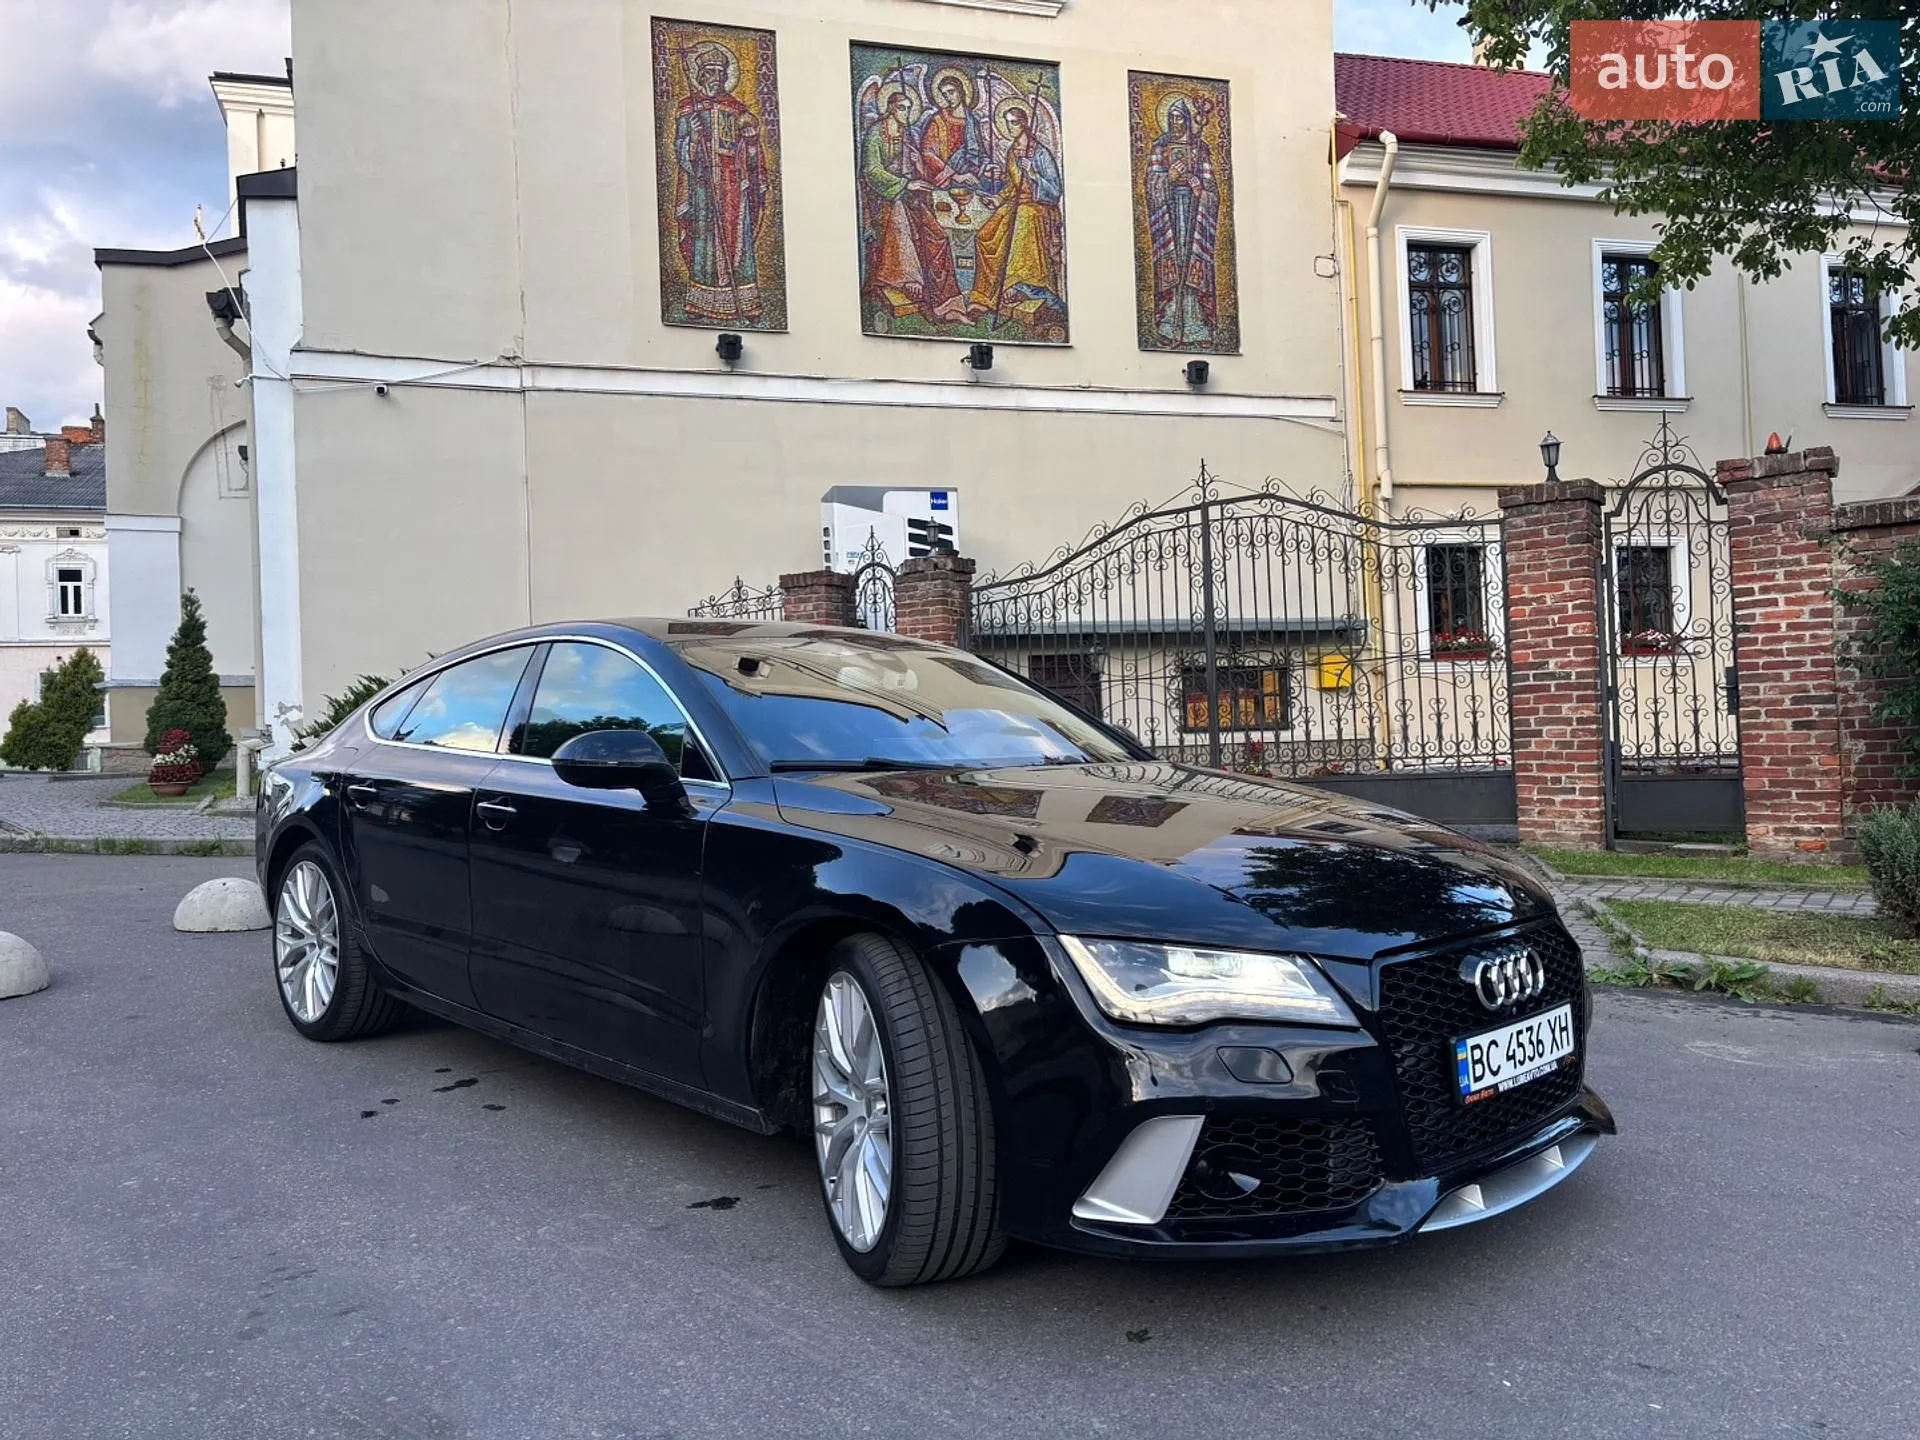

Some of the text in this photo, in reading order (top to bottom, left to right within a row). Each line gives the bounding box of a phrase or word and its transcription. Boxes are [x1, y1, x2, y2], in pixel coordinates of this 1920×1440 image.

[1470, 1012, 1571, 1083] BC 4536 XH
